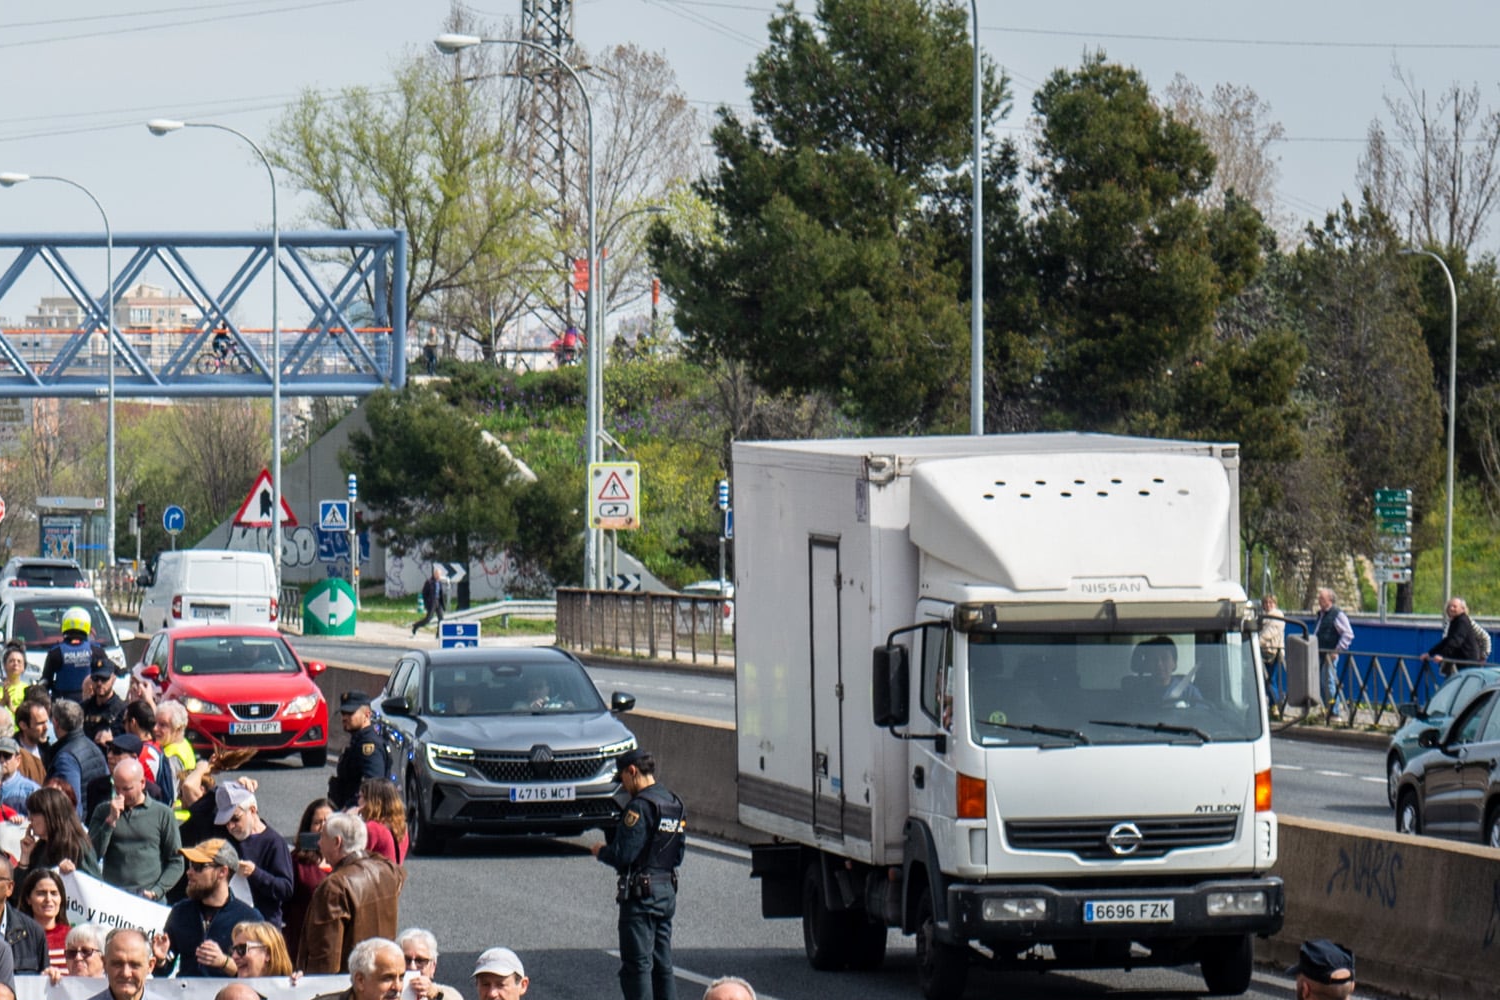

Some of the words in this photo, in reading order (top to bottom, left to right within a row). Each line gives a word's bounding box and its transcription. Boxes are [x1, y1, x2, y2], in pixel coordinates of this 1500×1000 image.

[1081, 582, 1141, 594] NISSAN
[518, 787, 547, 799] 4716
[551, 787, 573, 799] MCT
[1195, 803, 1241, 813] ATLEON
[1095, 903, 1135, 919] 6696
[1140, 902, 1170, 918] FZK
